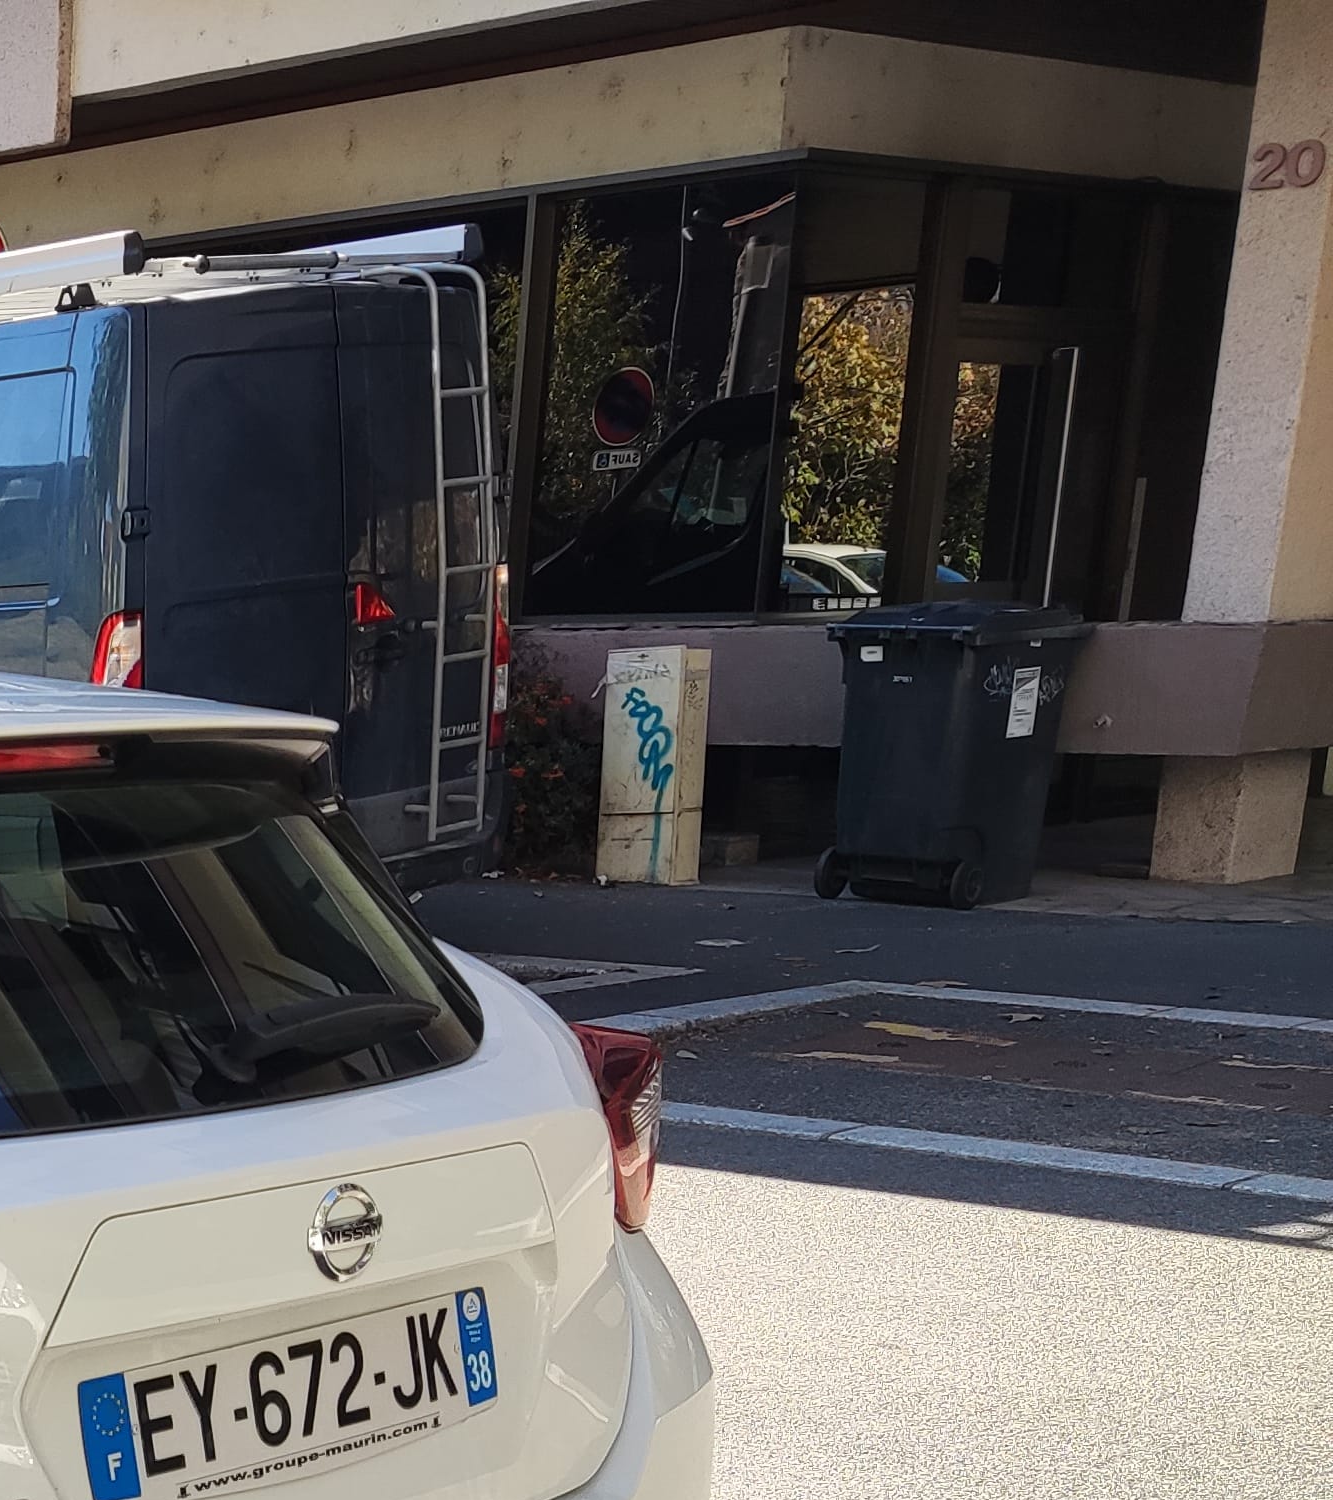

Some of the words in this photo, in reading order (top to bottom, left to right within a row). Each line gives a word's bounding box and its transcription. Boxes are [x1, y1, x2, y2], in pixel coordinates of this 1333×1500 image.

[1247, 139, 1326, 190] 20
[322, 1214, 383, 1247] NISSAN
[133, 1306, 459, 1478] EY-672-JK
[467, 1350, 492, 1392] 38
[105, 1451, 123, 1481] F
[194, 1420, 429, 1493] www.groupe-maurin.com
